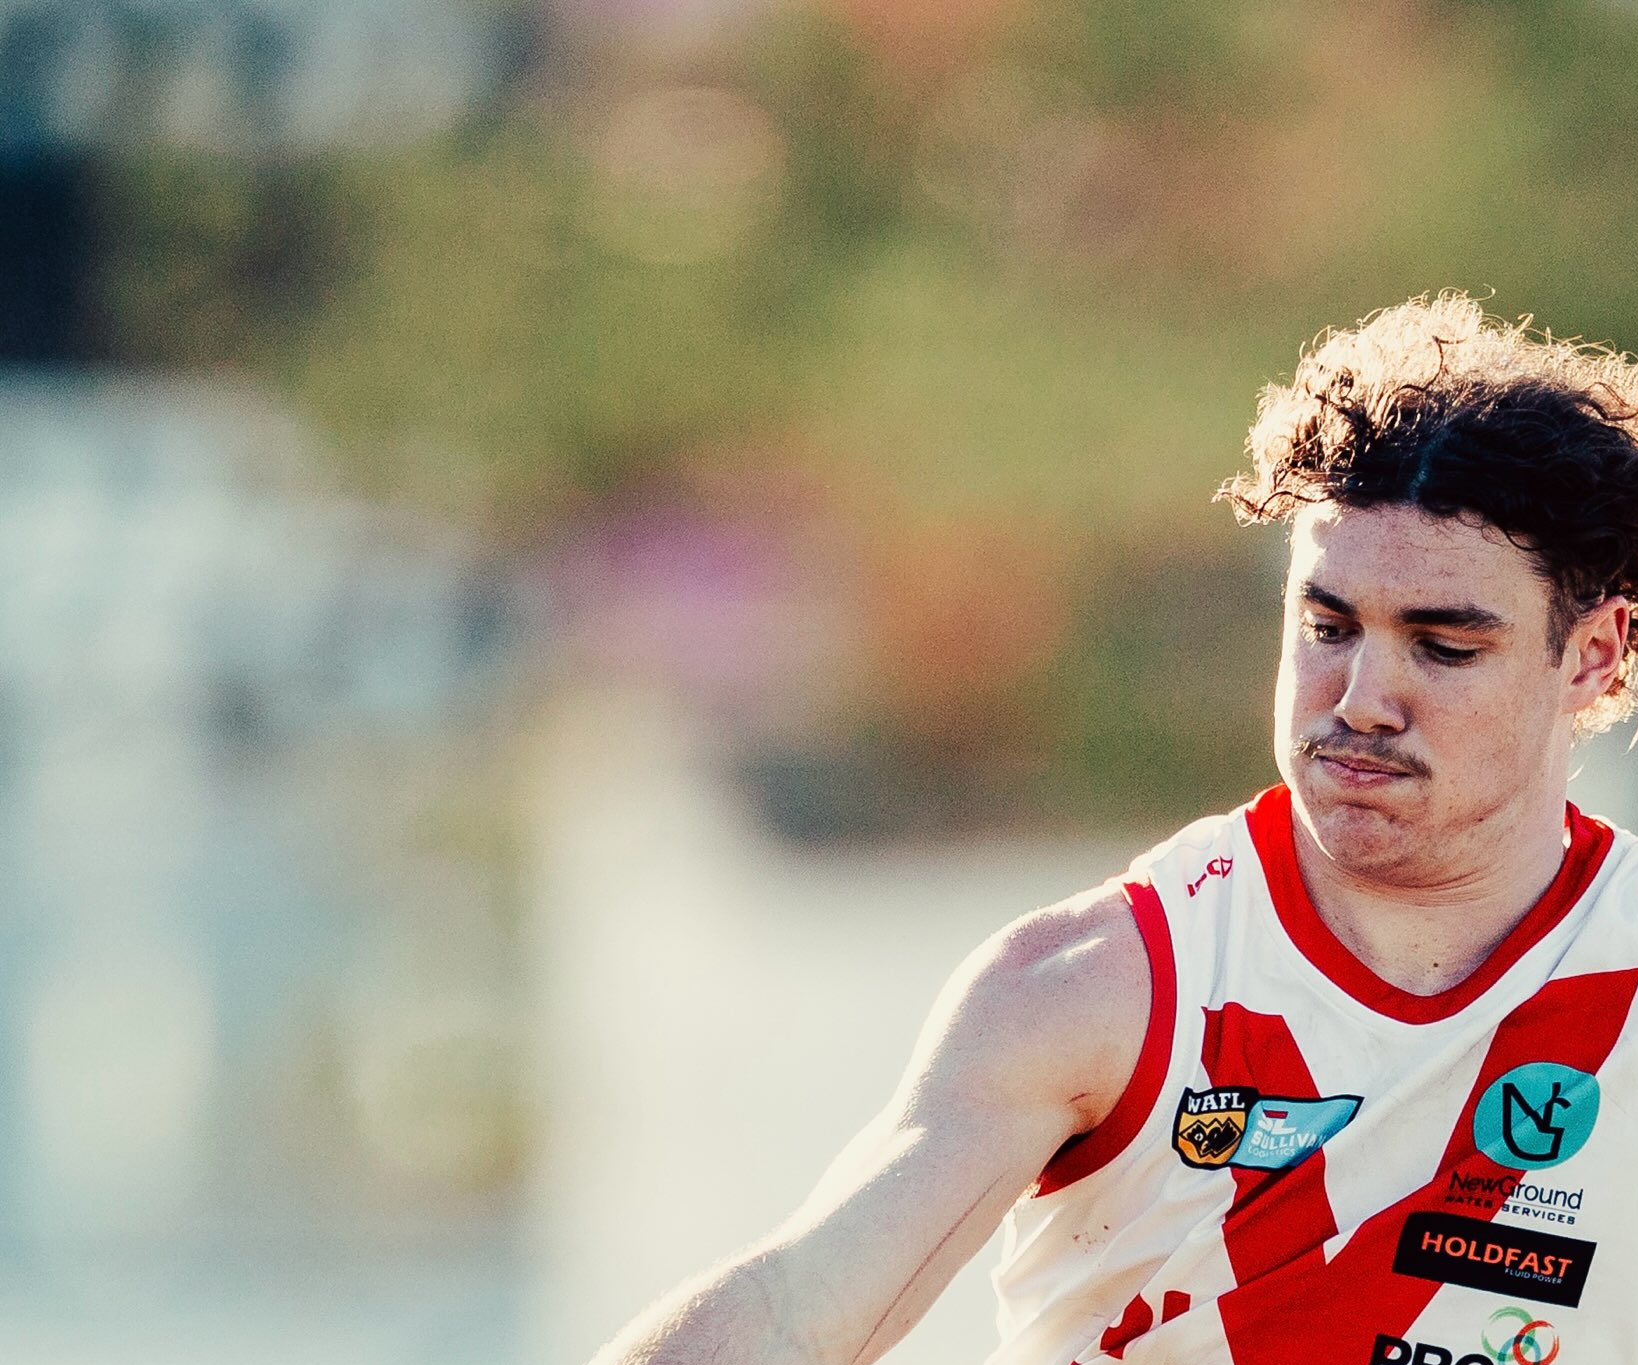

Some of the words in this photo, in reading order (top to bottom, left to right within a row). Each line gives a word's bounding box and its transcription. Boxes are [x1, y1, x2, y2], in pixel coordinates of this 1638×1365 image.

[1187, 1093, 1245, 1113] WAFL
[1449, 1171, 1584, 1210] NewGround
[1501, 1203, 1576, 1225] SERVICES
[1421, 1231, 1573, 1278] HOLDFAST
[1504, 1268, 1531, 1279] FLUID
[1532, 1273, 1563, 1284] POWER
